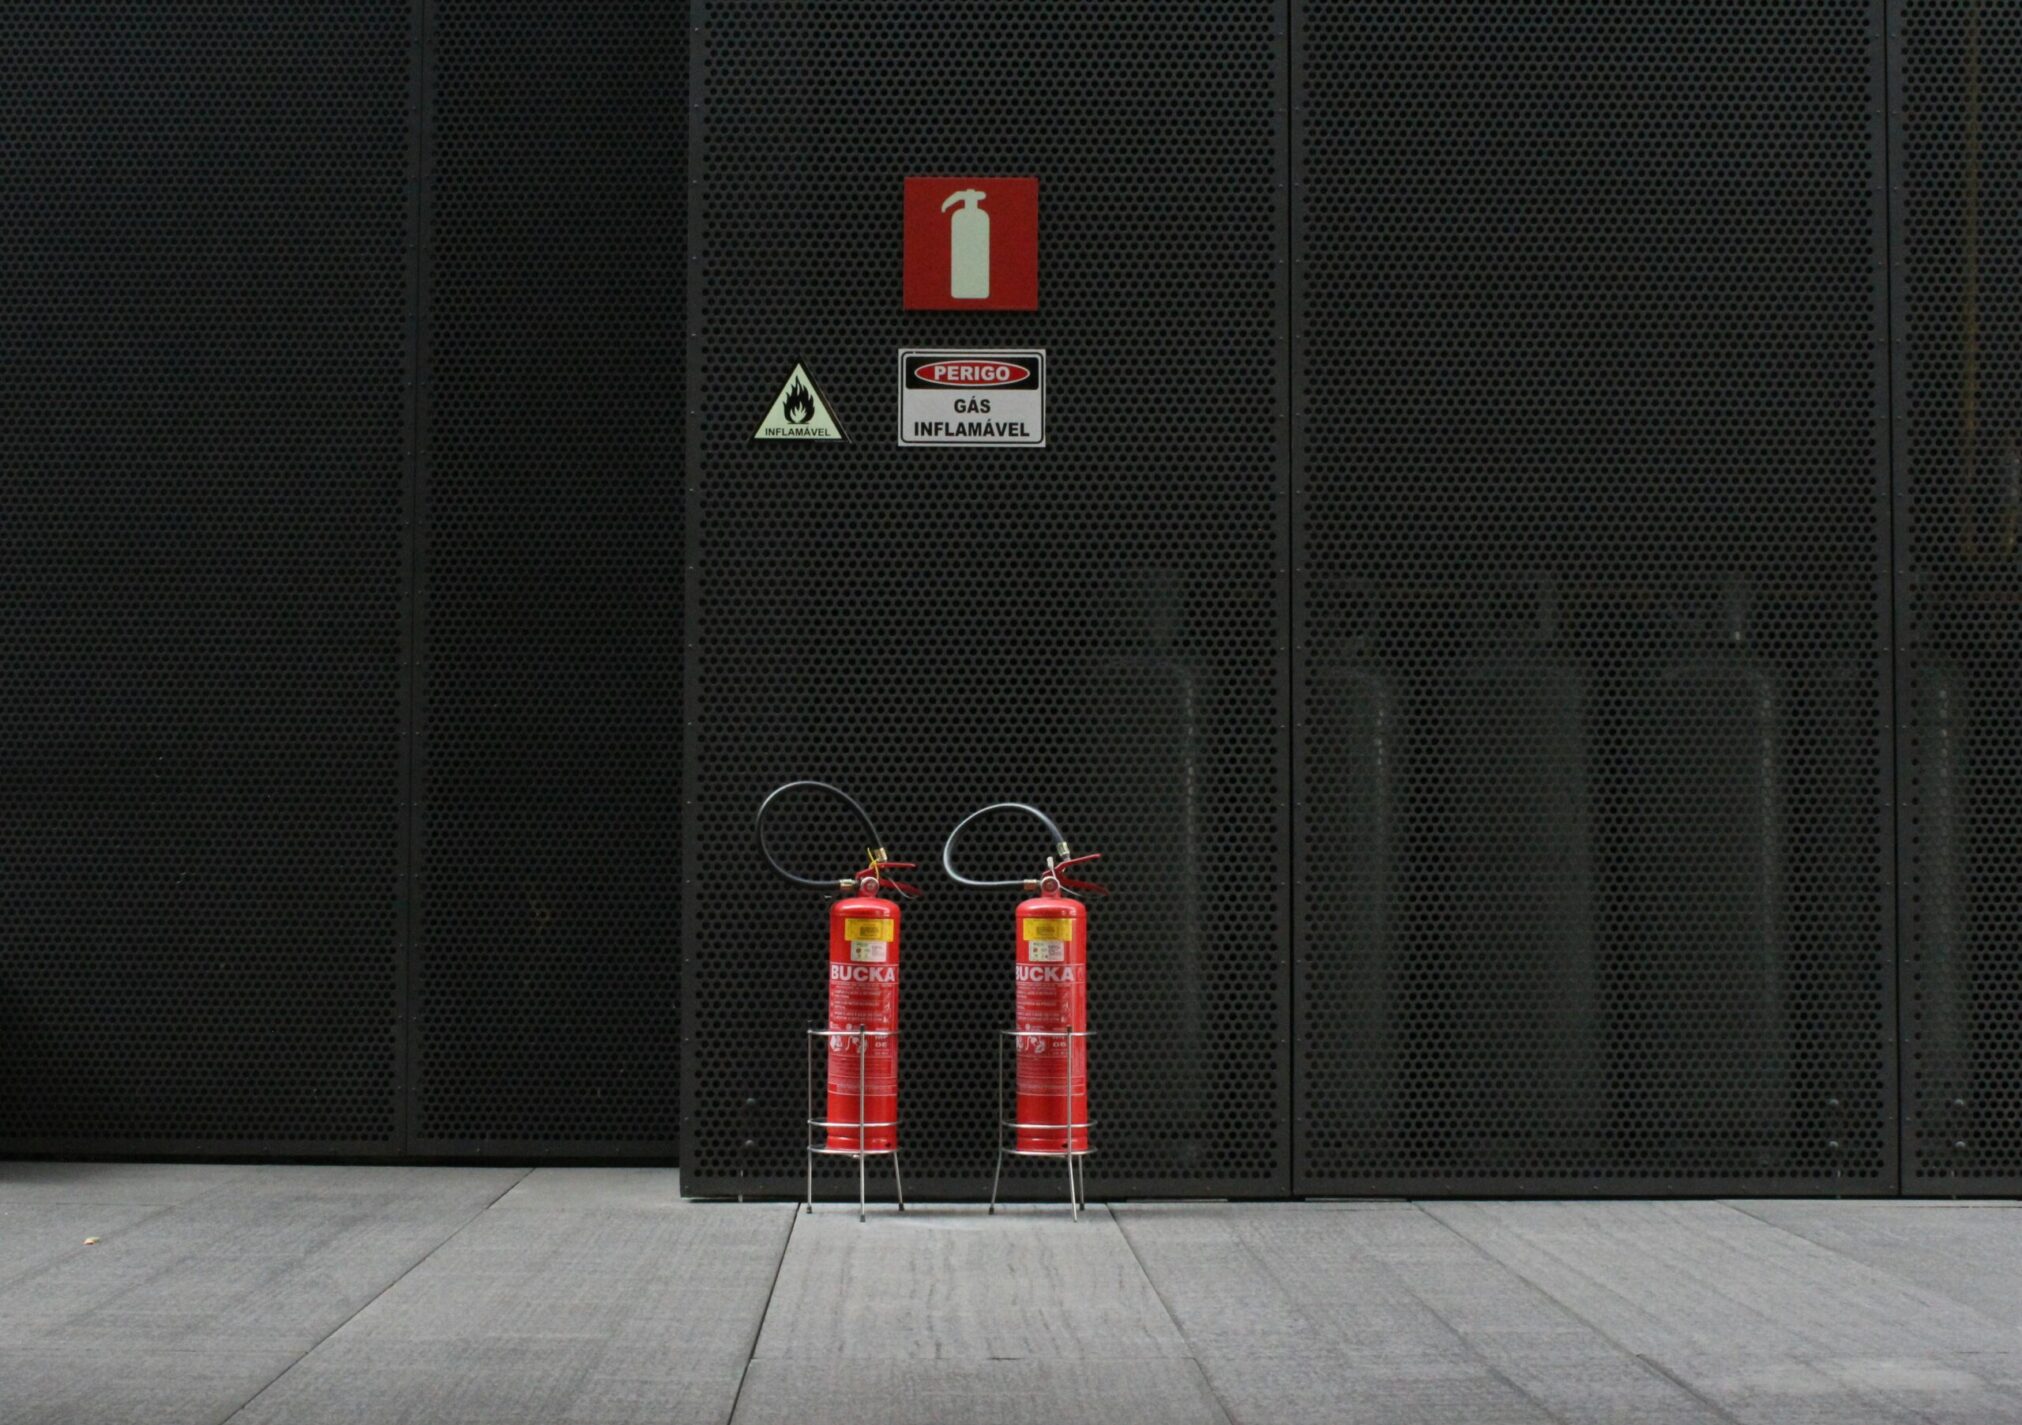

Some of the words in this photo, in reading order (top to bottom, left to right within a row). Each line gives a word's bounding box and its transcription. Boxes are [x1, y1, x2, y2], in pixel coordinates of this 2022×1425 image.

[934, 366, 1010, 381] PERIGO
[953, 396, 991, 413] GÁS
[765, 426, 831, 437] INFLAMÁVEL
[914, 418, 1030, 437] INFLAMÁVEL
[831, 964, 895, 982] BUCKA
